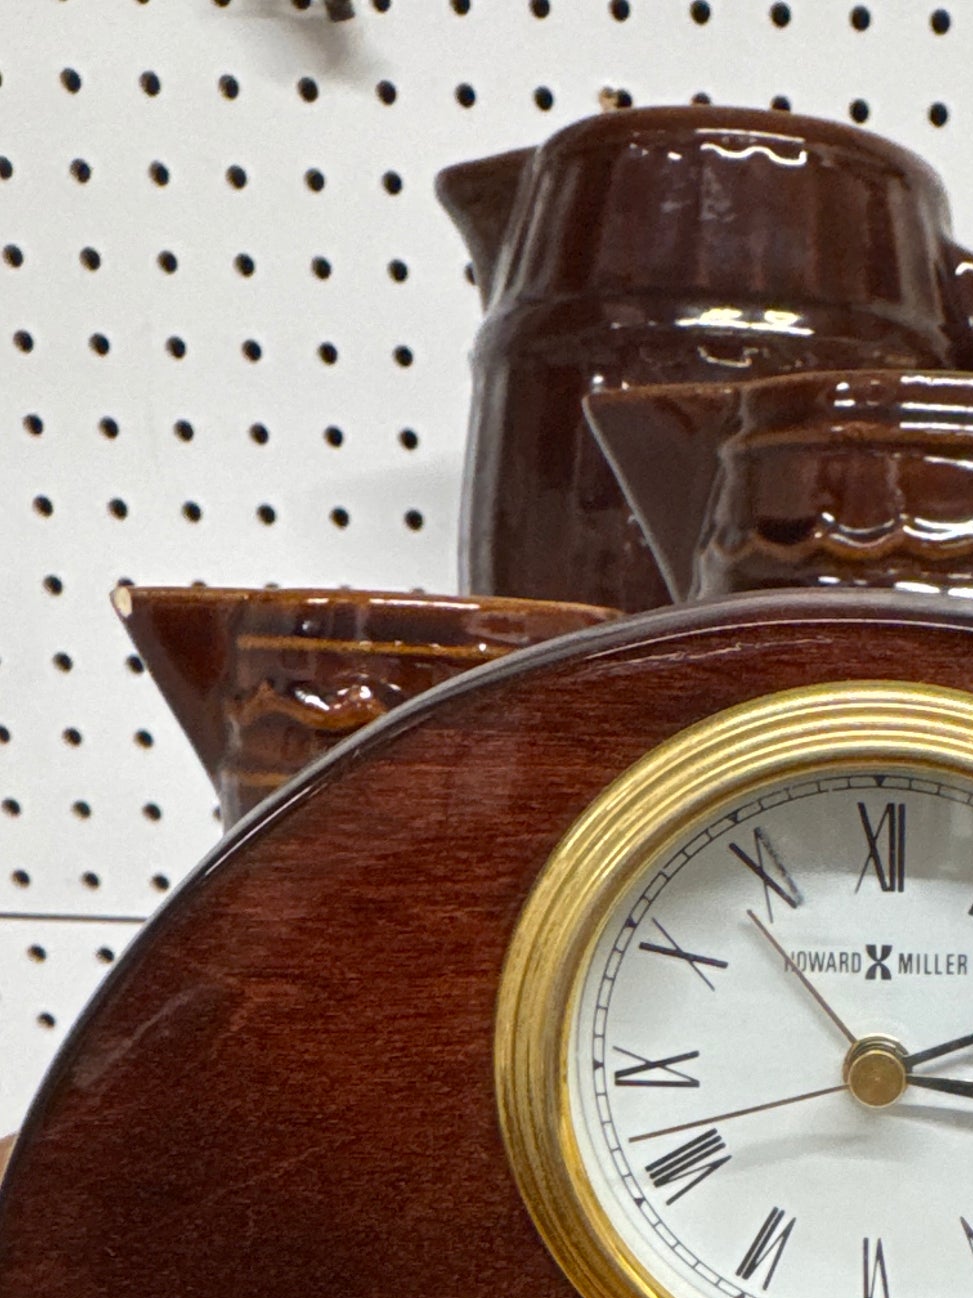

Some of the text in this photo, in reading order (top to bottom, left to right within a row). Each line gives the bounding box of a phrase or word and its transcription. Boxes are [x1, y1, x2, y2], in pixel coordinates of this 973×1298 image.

[855, 802, 905, 893] XII
[638, 917, 728, 991] X
[898, 952, 968, 976] MILLER
[613, 1046, 700, 1088] IX
[644, 1127, 732, 1206] VIII
[735, 1206, 797, 1290] VII
